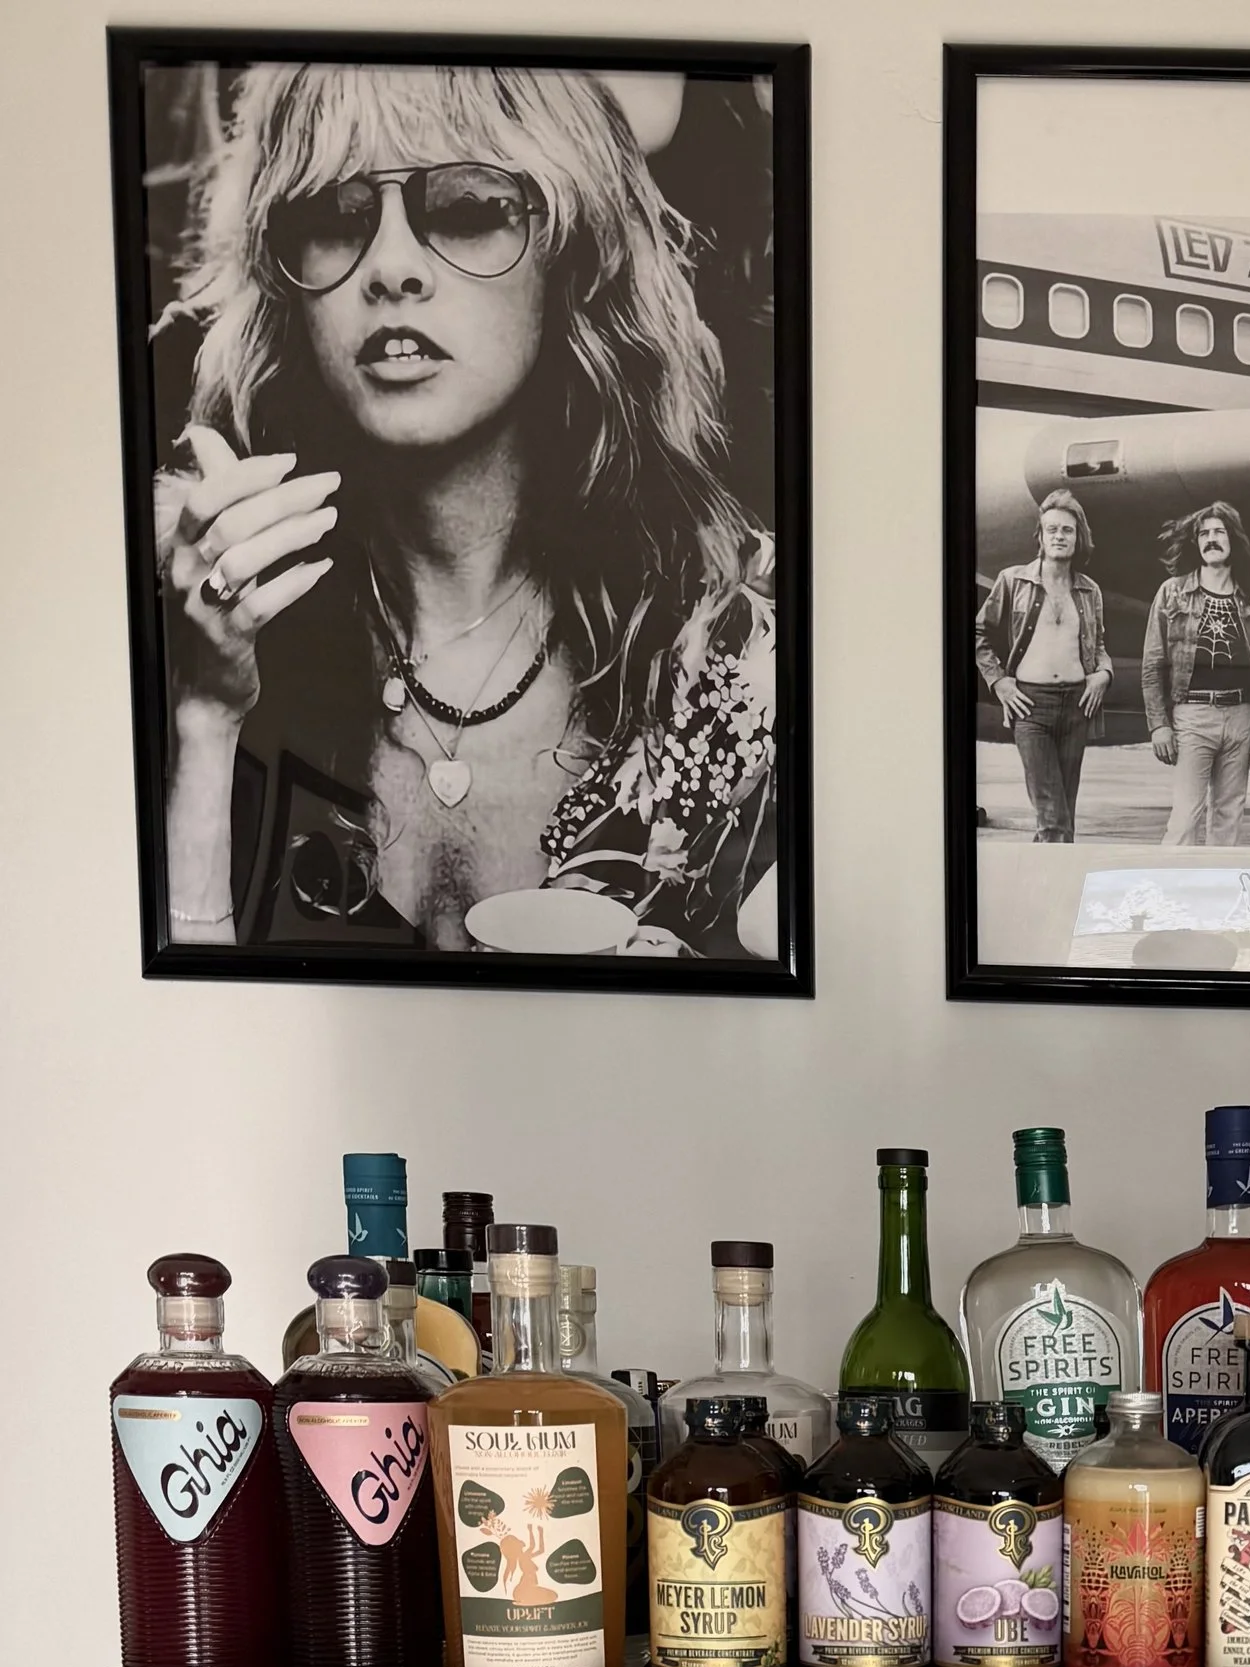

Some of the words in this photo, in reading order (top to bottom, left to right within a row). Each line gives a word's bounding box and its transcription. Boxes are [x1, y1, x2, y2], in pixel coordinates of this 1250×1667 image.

[1170, 226, 1233, 272] LED
[1023, 1333, 1097, 1356] FREE
[1009, 1356, 1112, 1381] SPIRITS
[1030, 1388, 1049, 1396] THE
[1052, 1386, 1083, 1396] SPIRIT
[1036, 1396, 1095, 1417] GIN
[465, 1431, 522, 1451] SOUL
[160, 1409, 248, 1519] Ghia
[351, 1415, 425, 1525] Ghia
[656, 1584, 705, 1610] MEYER
[710, 1585, 766, 1609] LEMON
[506, 1606, 556, 1621] UPLIFT
[680, 1611, 738, 1635] SYRUP
[804, 1614, 883, 1642] LAVENDER
[994, 1618, 1029, 1642] UBE
